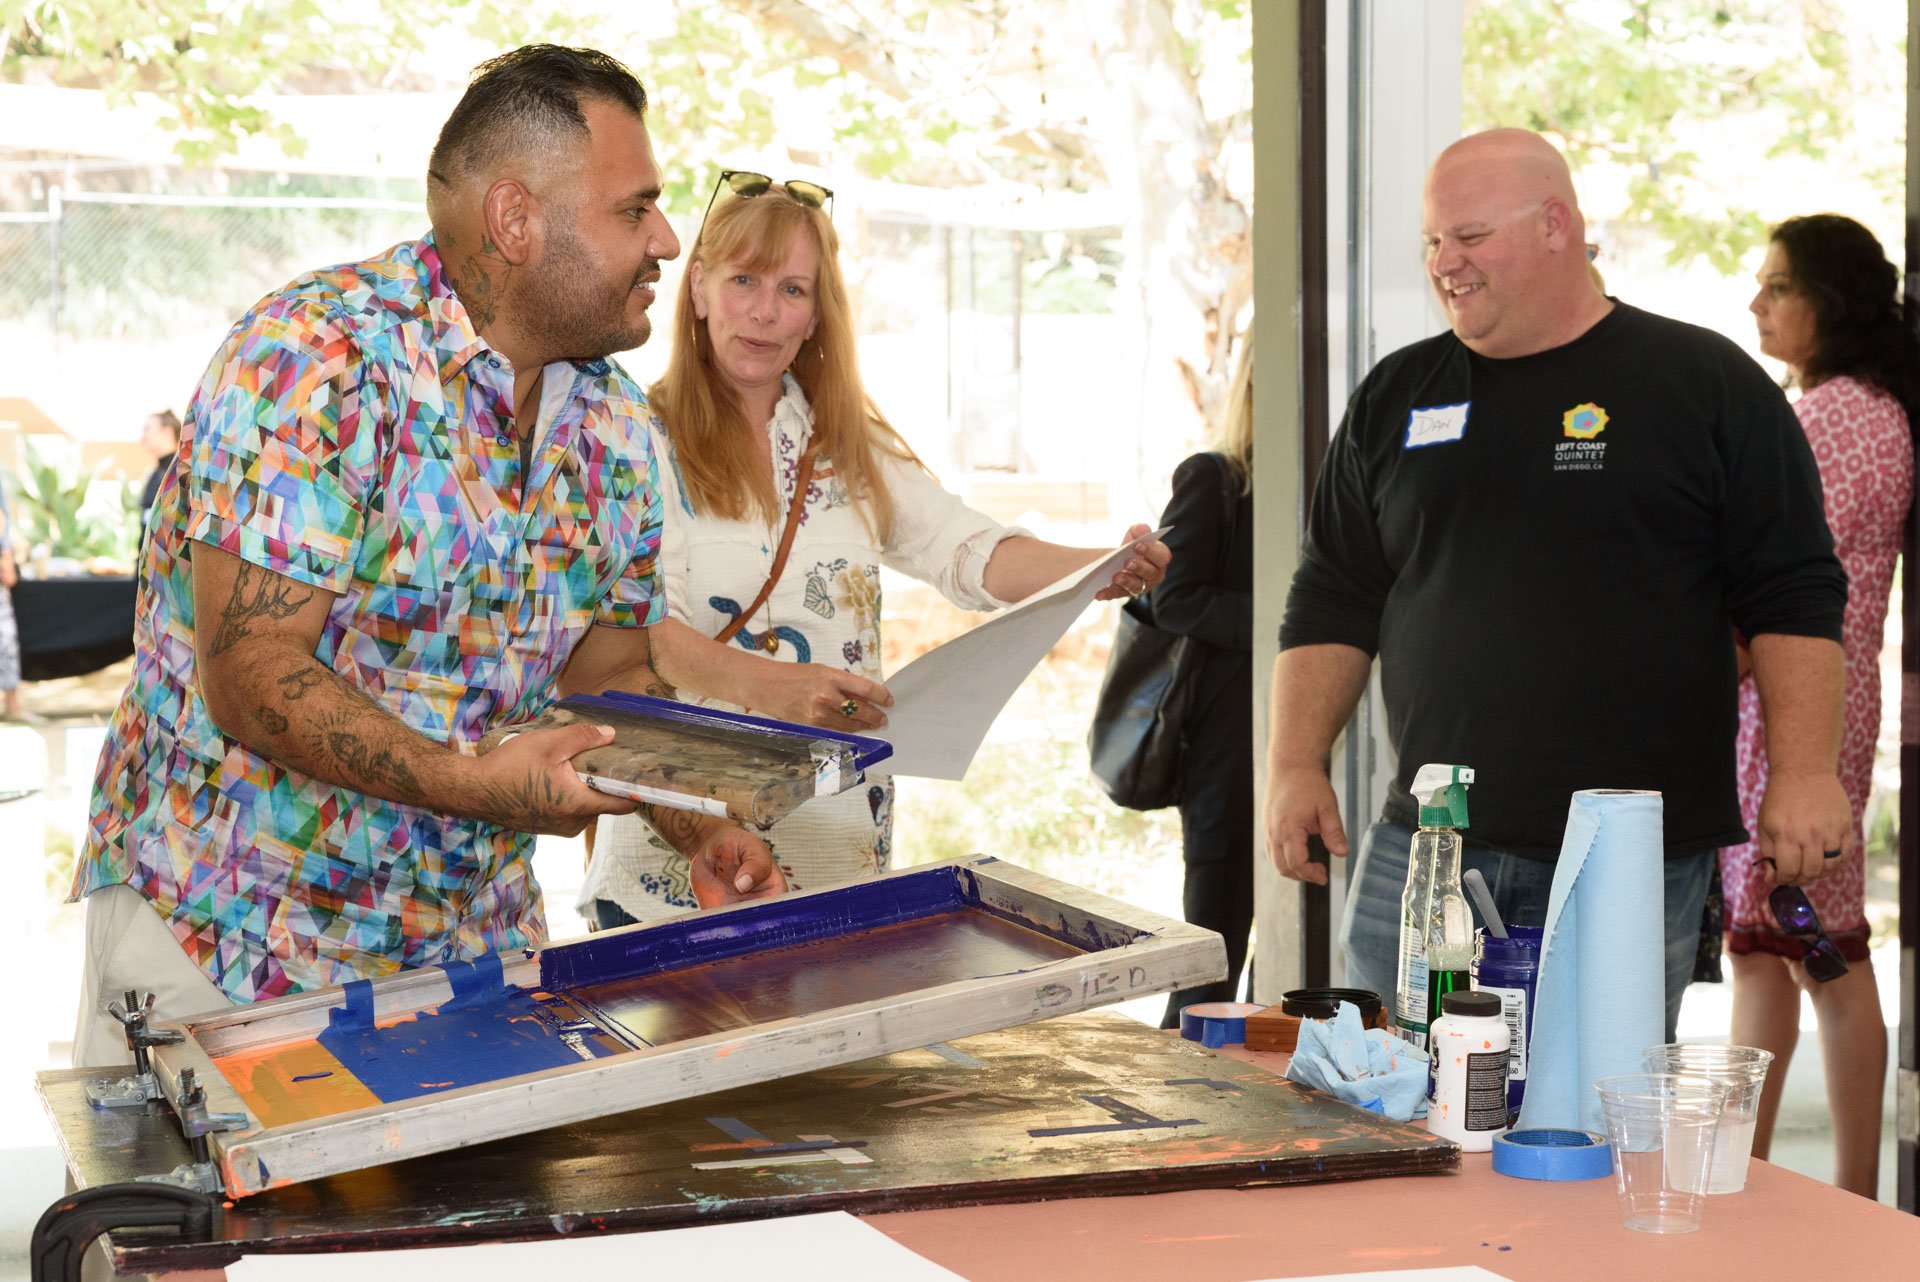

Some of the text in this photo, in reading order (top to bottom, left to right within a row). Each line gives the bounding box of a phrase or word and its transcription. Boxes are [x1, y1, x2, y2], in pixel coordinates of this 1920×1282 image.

[1555, 441, 1607, 451] LEFT COAST
[1554, 450, 1606, 461] QUINTET
